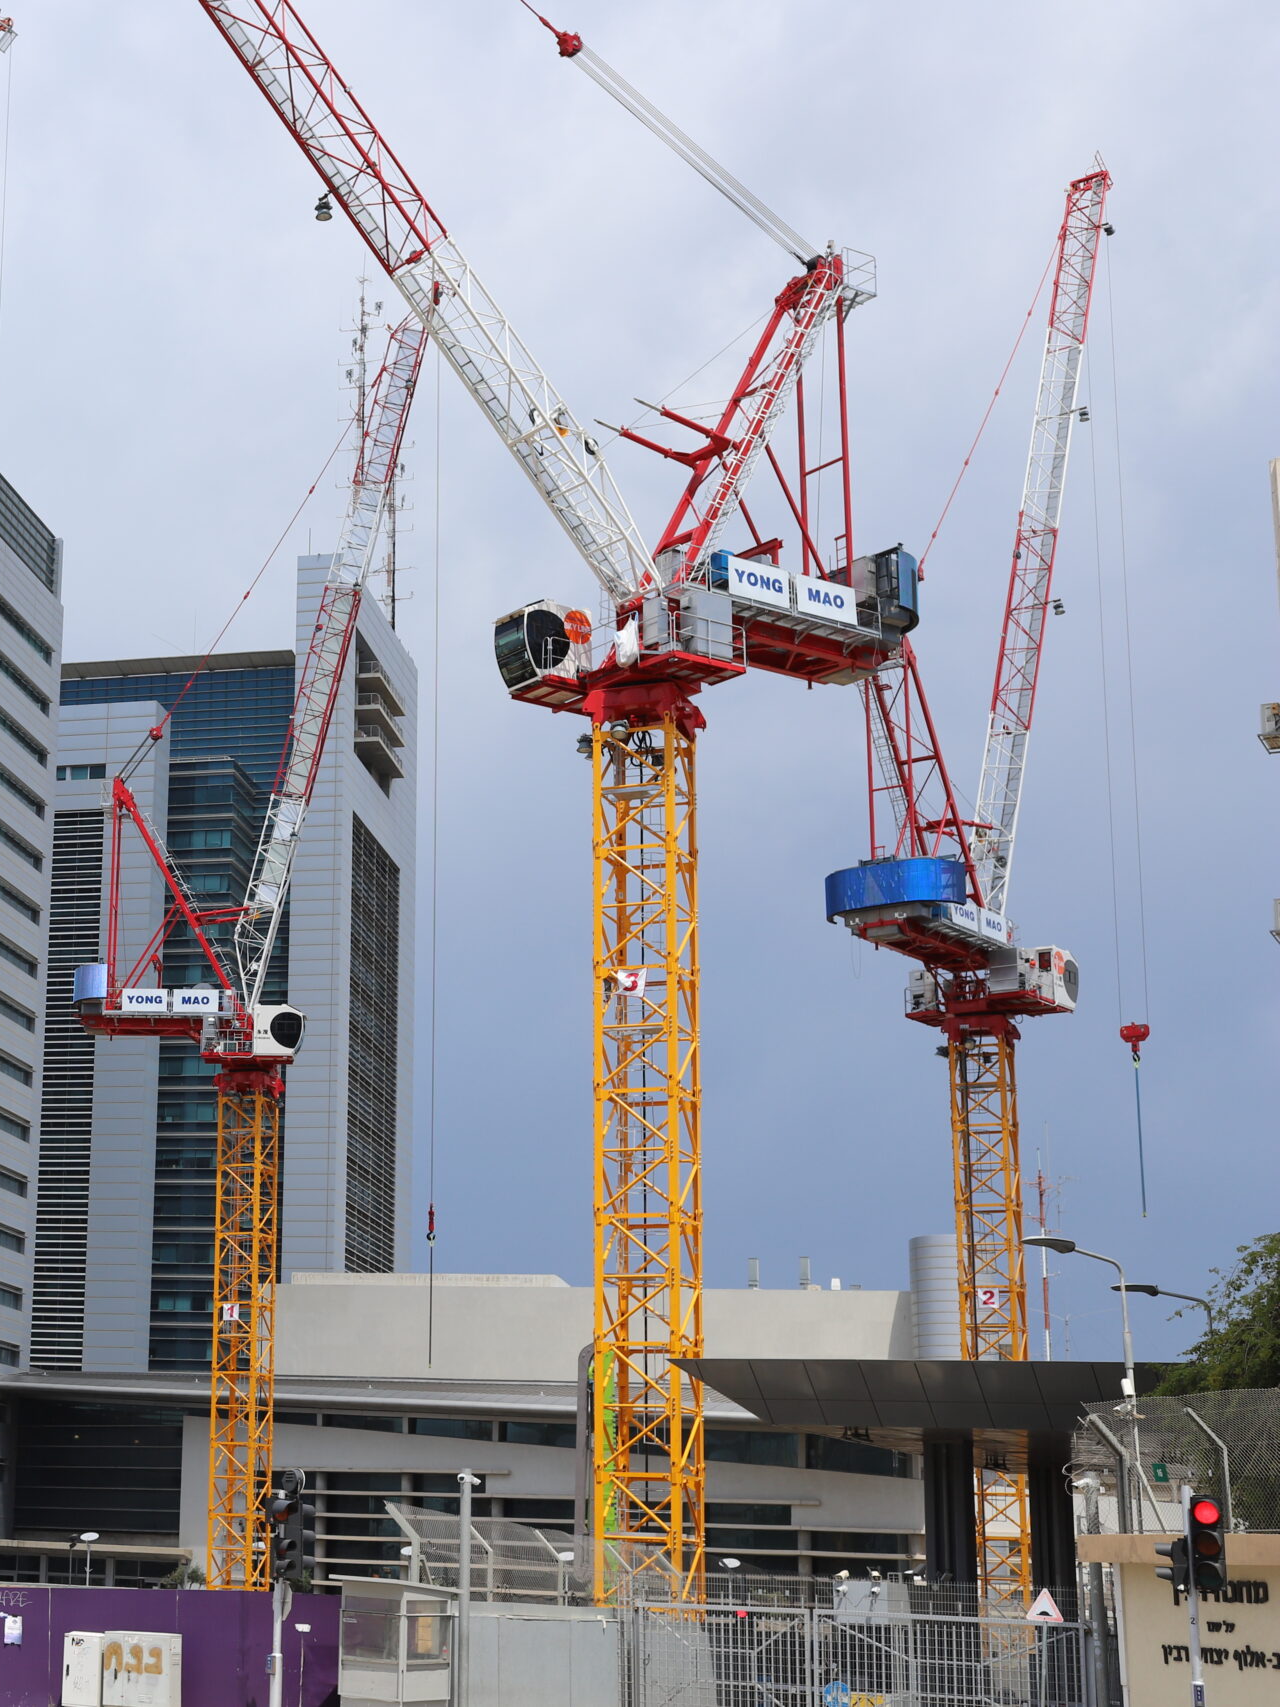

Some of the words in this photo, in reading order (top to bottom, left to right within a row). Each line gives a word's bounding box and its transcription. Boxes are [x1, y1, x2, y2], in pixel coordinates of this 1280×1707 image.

[733, 568, 784, 594] YONG
[807, 587, 846, 609] MAO
[953, 904, 976, 922] YONG
[985, 916, 1002, 932] MAO
[622, 972, 640, 992] 3
[126, 995, 163, 1005] YONG
[181, 995, 210, 1005] MAO
[982, 1290, 996, 1305] 2
[226, 1305, 235, 1318] 1
[1190, 1616, 1196, 1625] 2
[1206, 1620, 1222, 1633] שם
[1222, 1619, 1235, 1633] על
[1161, 1644, 1190, 1665] רבין
[1200, 1646, 1229, 1665] יצח
